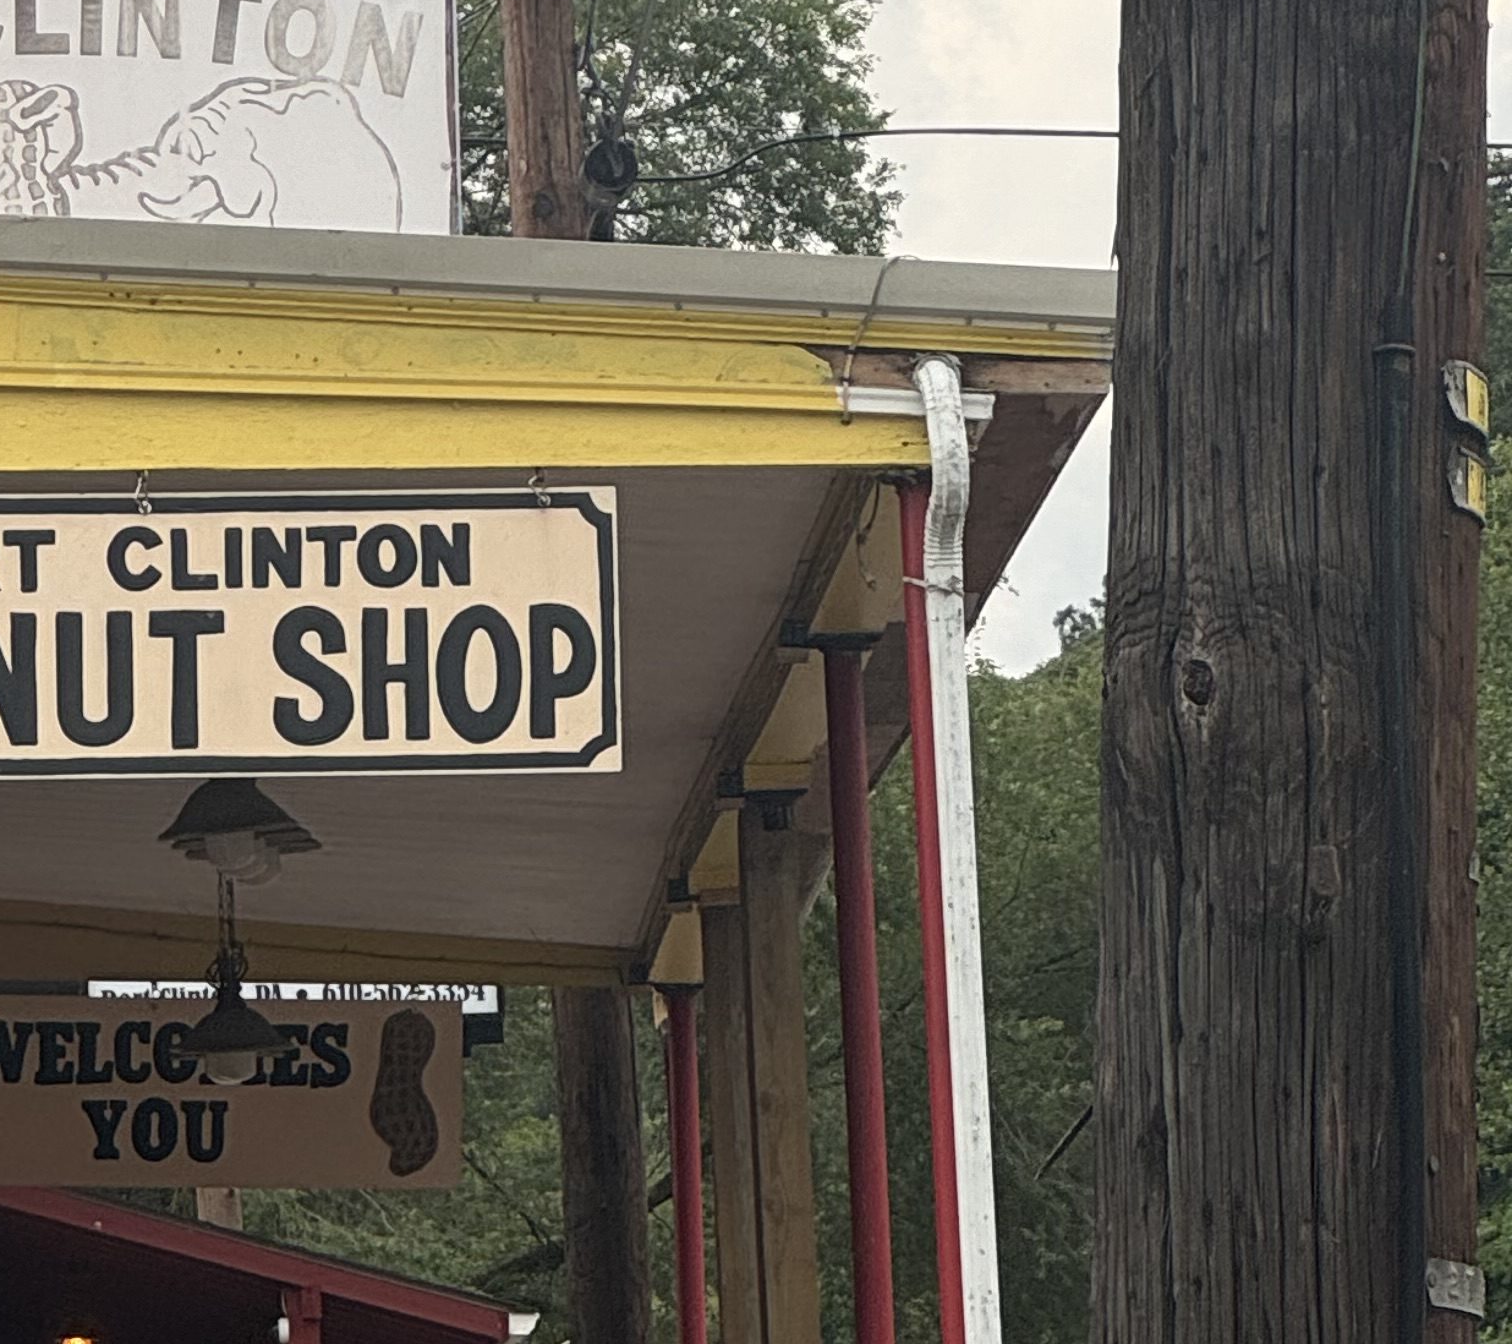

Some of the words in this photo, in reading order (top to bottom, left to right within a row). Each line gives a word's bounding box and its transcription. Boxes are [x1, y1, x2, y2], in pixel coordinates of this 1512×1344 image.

[106, 522, 471, 592] CLINTON
[272, 603, 597, 747] SHOP
[80, 1097, 229, 1163] YOU
